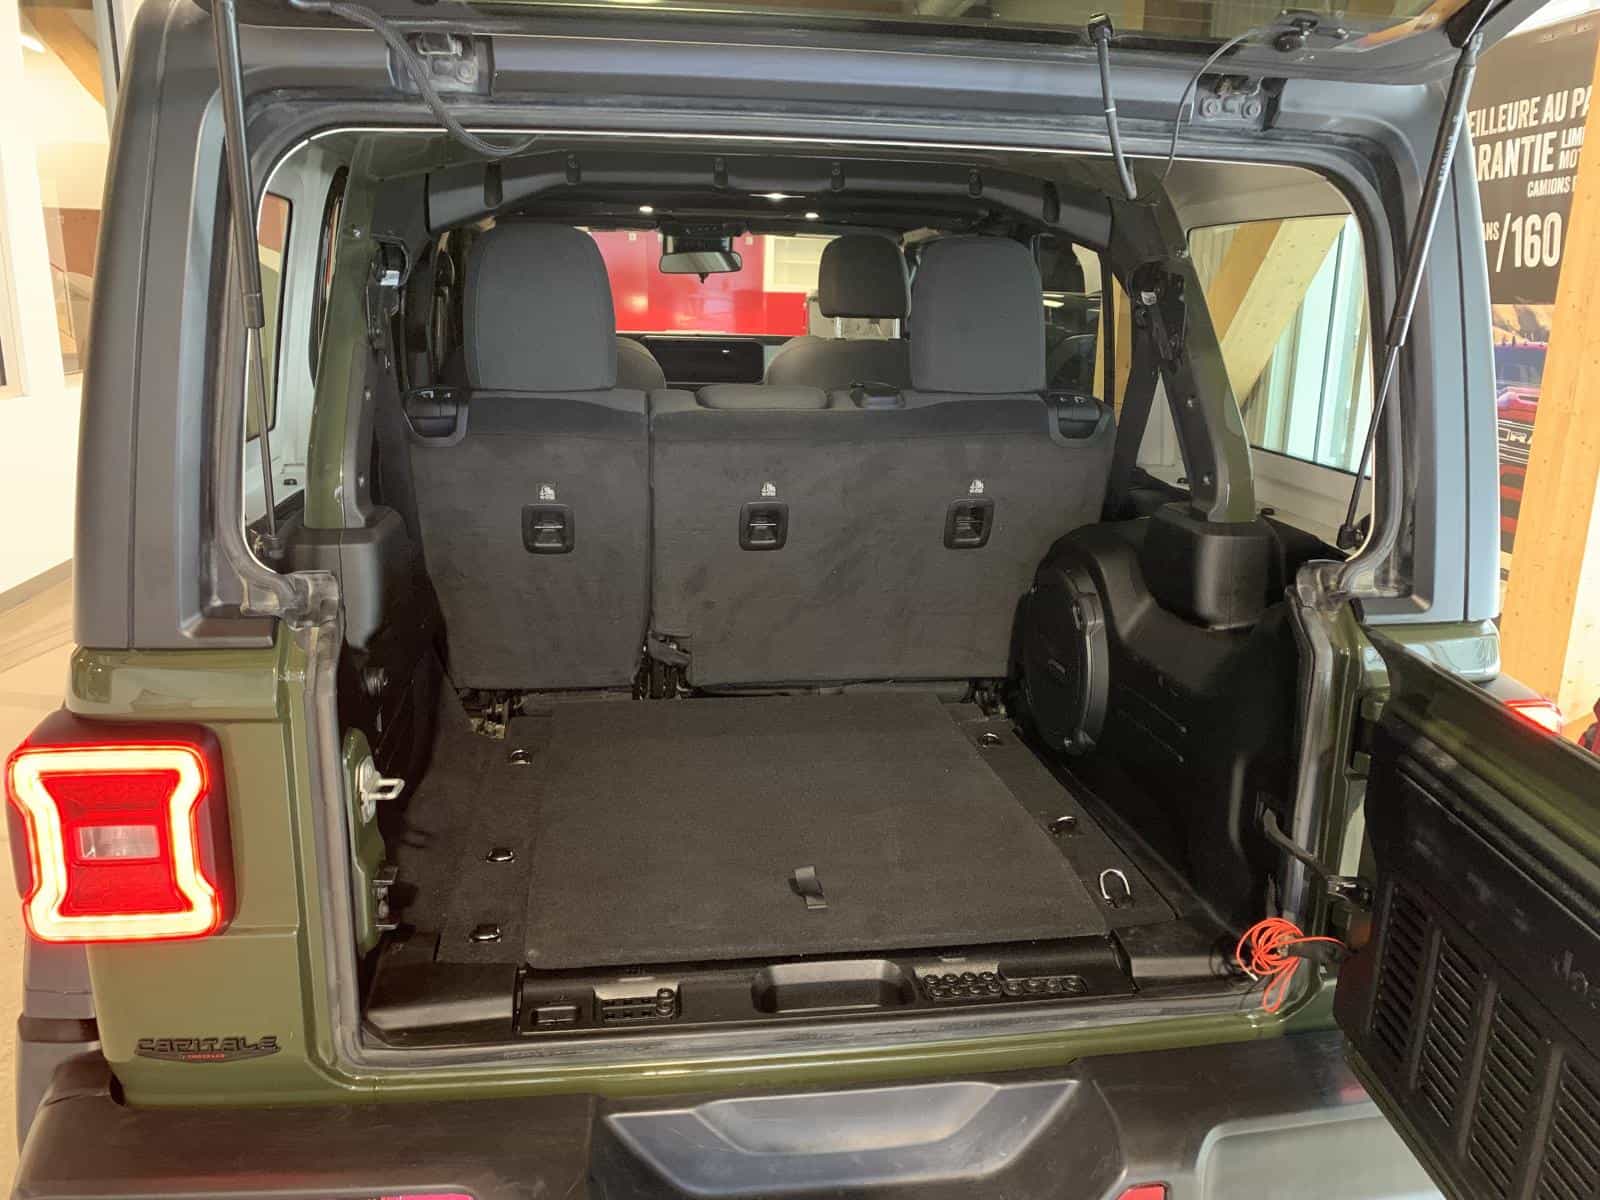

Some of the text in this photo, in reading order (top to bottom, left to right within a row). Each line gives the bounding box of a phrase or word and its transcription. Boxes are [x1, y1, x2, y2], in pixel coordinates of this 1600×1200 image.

[1541, 90, 1569, 125] AU
[1474, 131, 1558, 182] RANTIE
[1527, 176, 1571, 198] CAMIONS
[1496, 211, 1562, 272] /160
